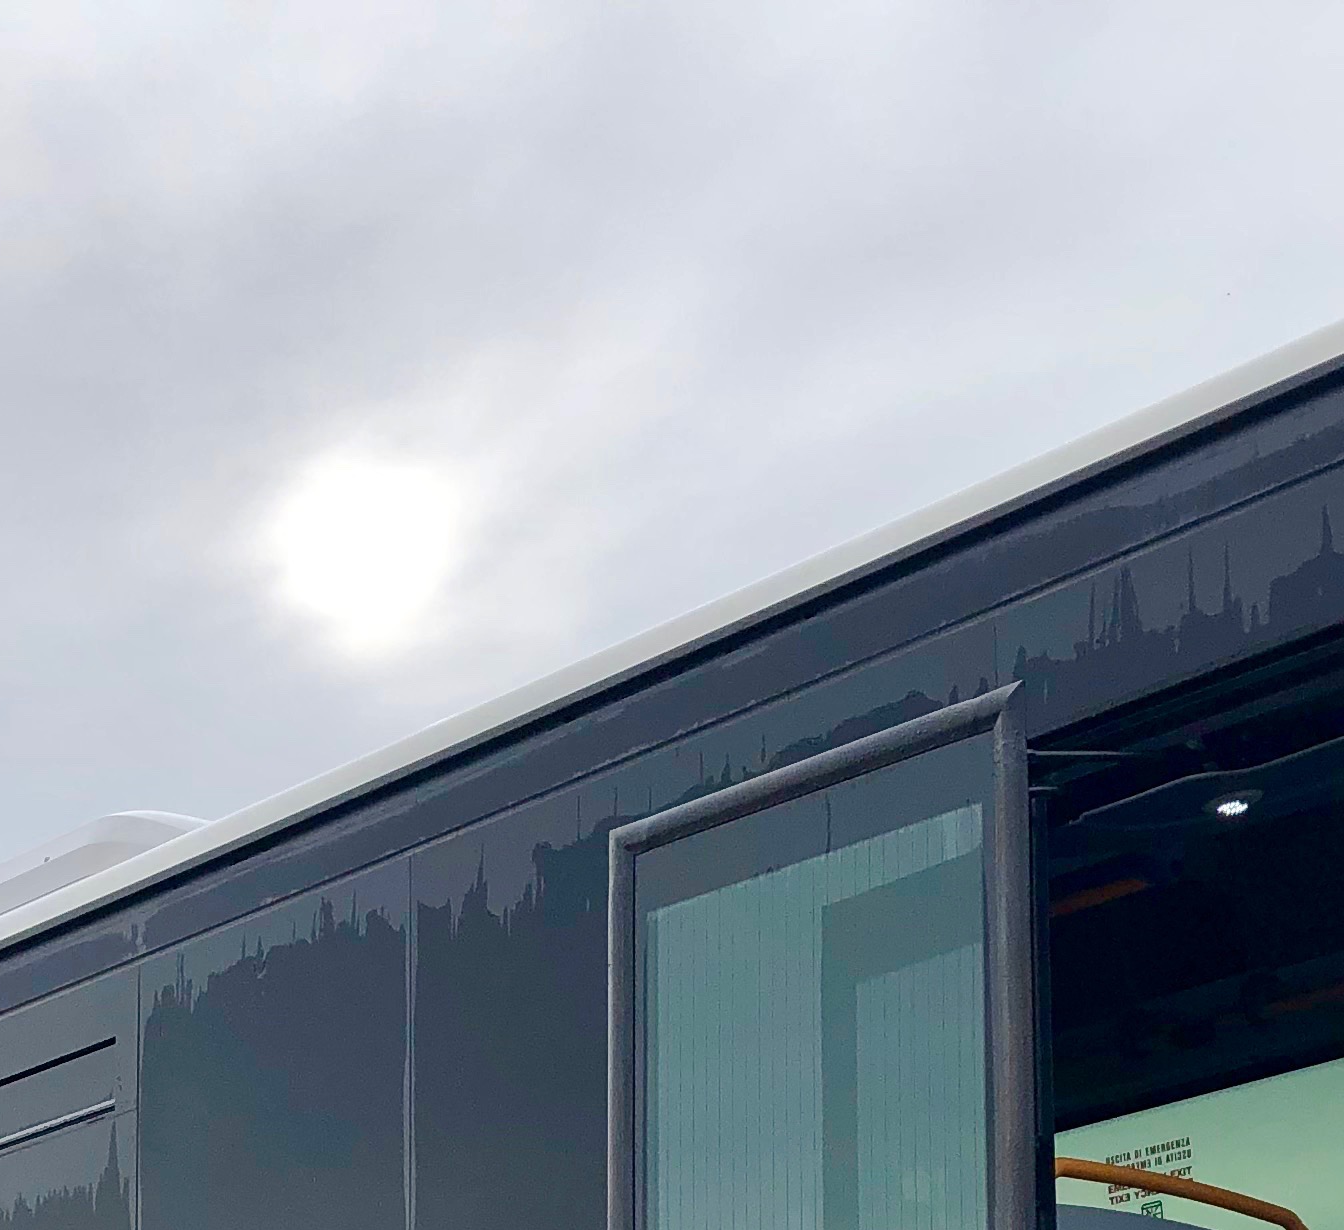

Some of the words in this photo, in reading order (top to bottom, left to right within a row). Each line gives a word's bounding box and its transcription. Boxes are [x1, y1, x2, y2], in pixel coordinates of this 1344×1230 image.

[1105, 1151, 1132, 1165] USCITA
[1134, 1149, 1142, 1160] DI
[1145, 1136, 1191, 1156] EMERGENZA
